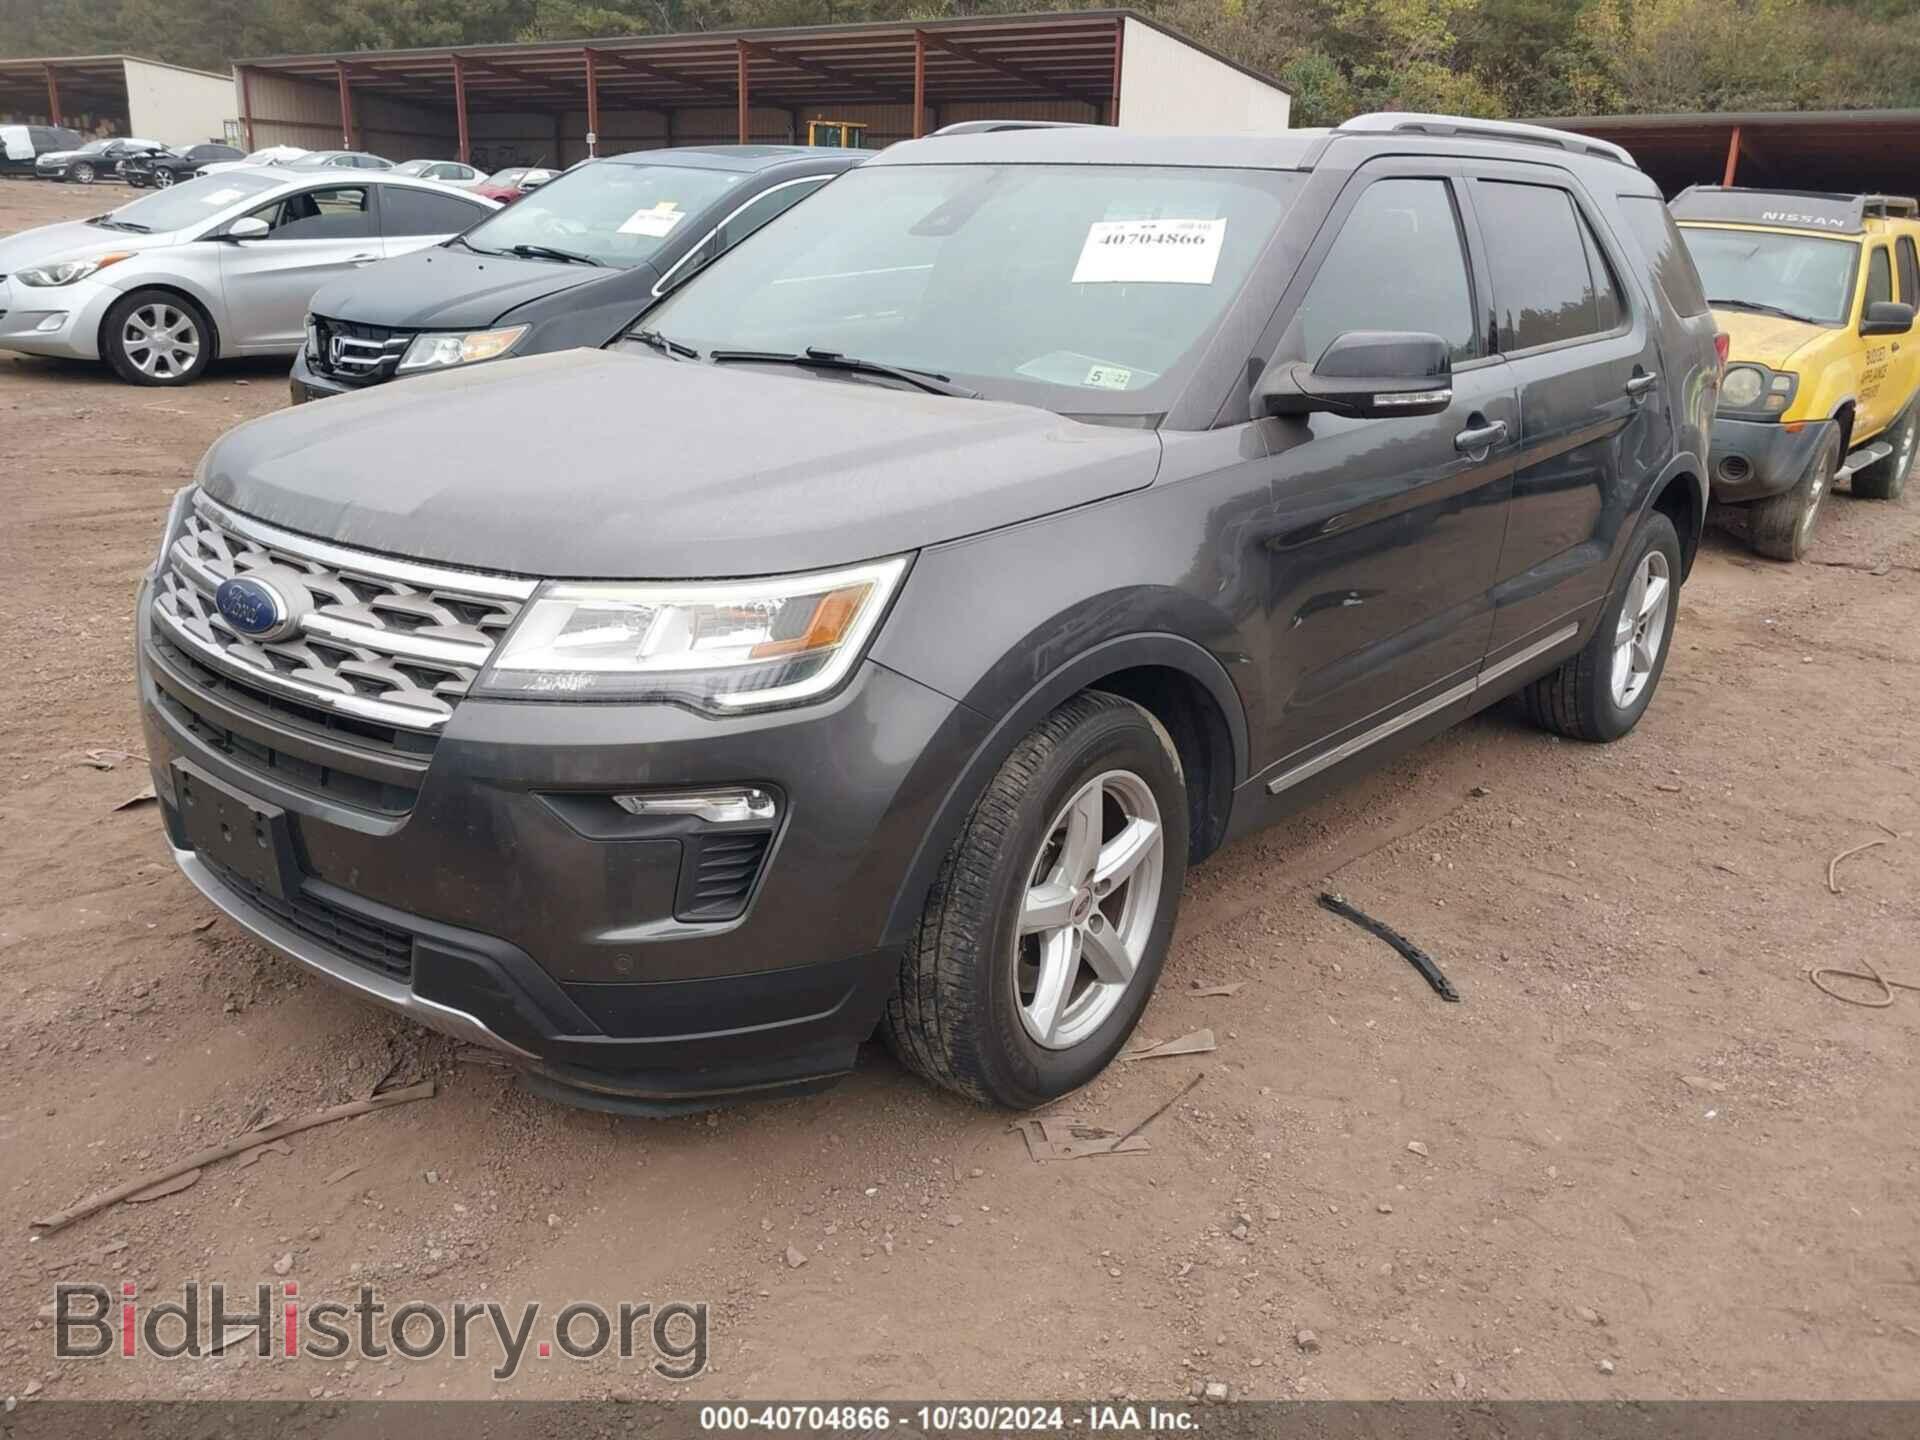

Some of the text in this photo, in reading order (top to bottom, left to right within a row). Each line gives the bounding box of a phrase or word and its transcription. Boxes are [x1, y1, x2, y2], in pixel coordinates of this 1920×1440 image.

[1762, 211, 1845, 227] NISSAN
[1099, 233, 1206, 246] 40704866
[1091, 370, 1103, 382] 5
[222, 584, 263, 624] Ford
